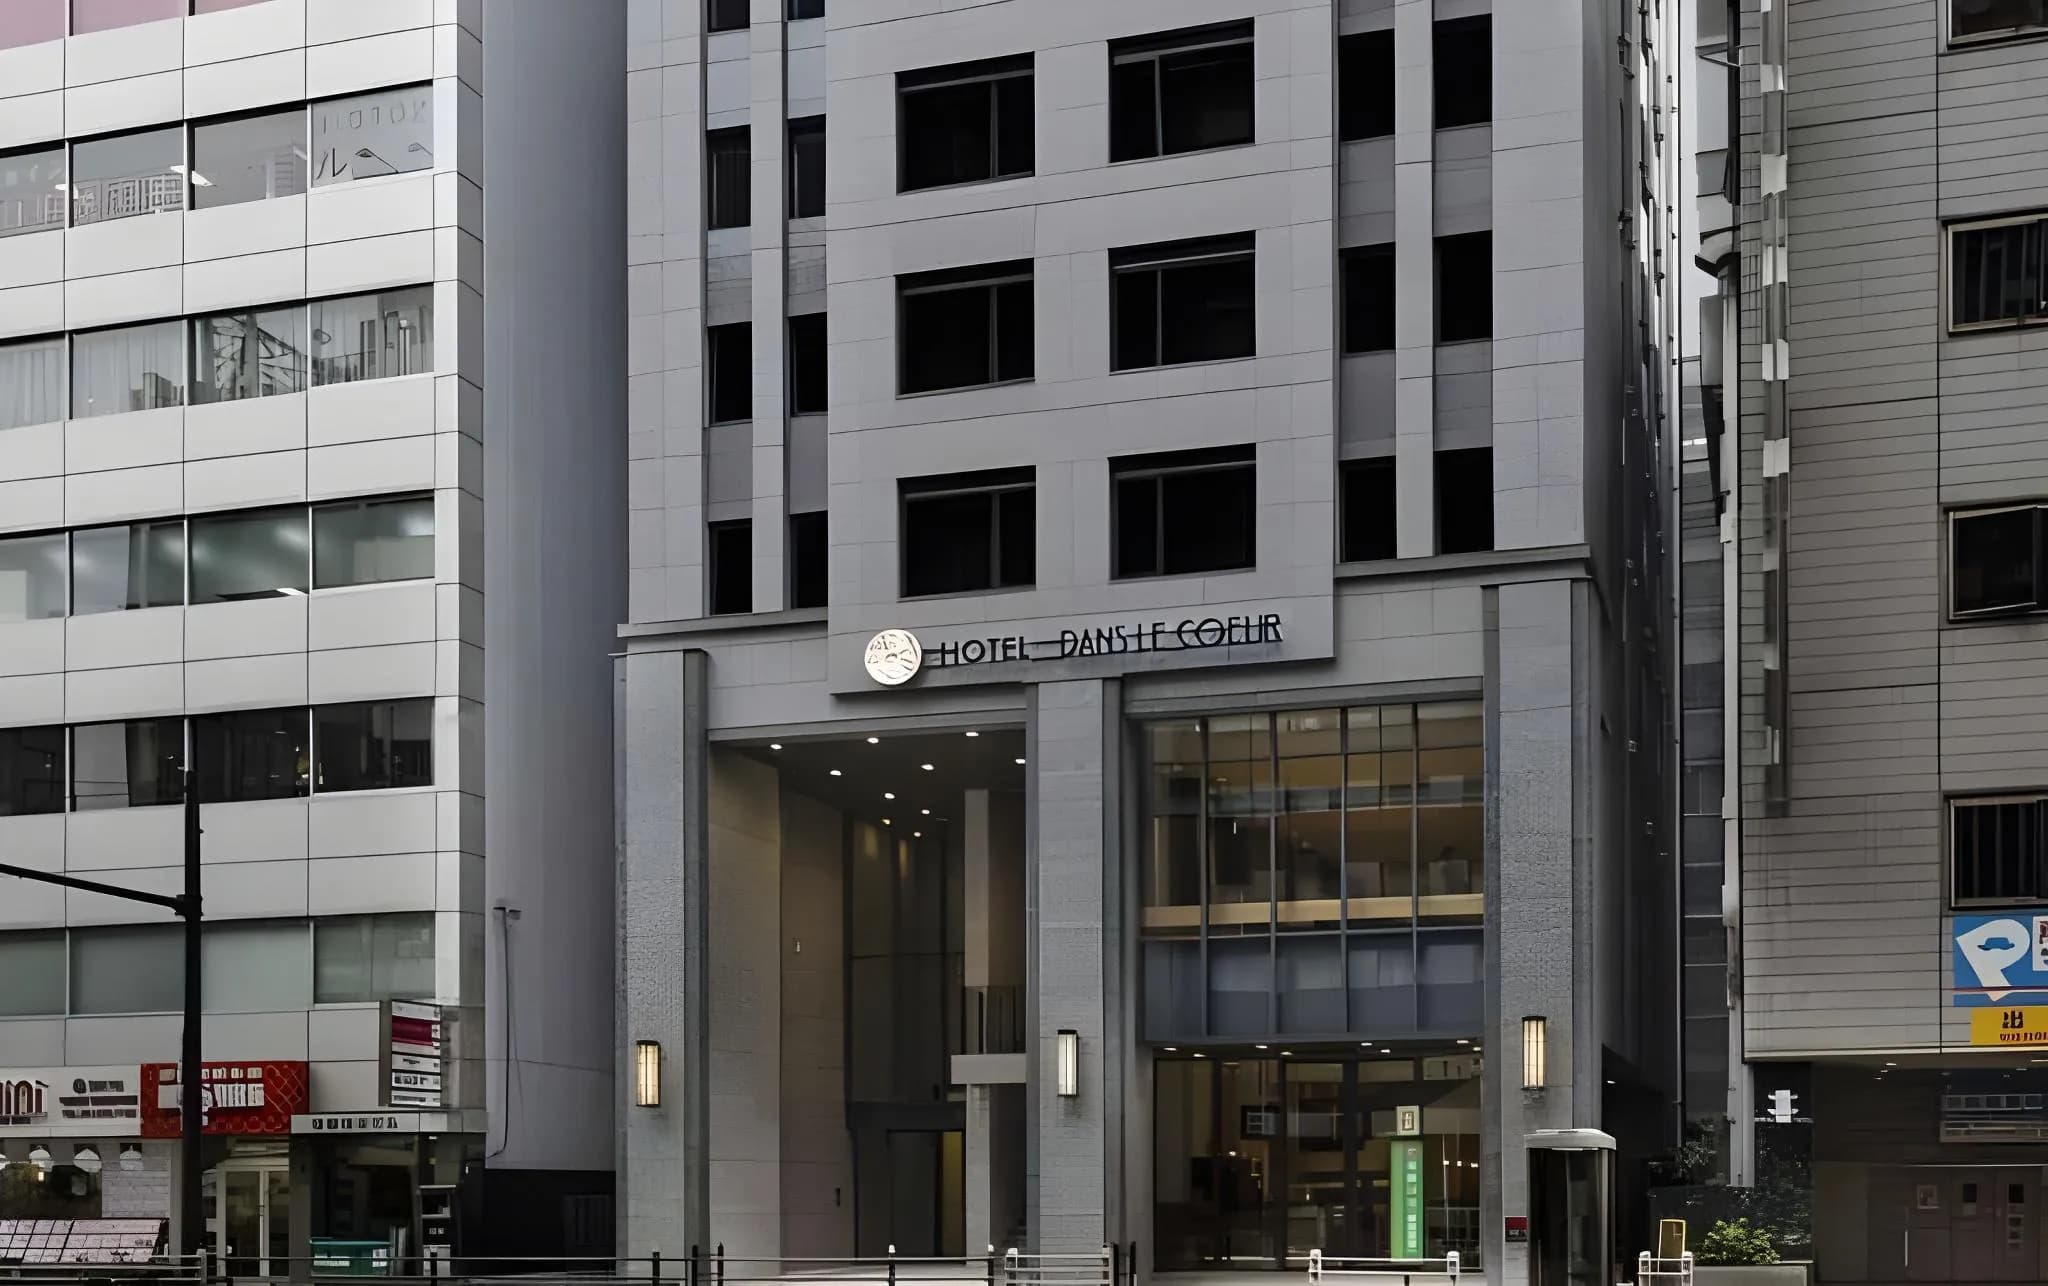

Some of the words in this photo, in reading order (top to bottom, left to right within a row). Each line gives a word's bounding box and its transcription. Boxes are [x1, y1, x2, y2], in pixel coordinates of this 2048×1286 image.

[940, 636, 1030, 667] HOTEL
[1060, 625, 1128, 657] DANS
[1137, 622, 1166, 652] LE
[1176, 613, 1284, 648] COEUR
